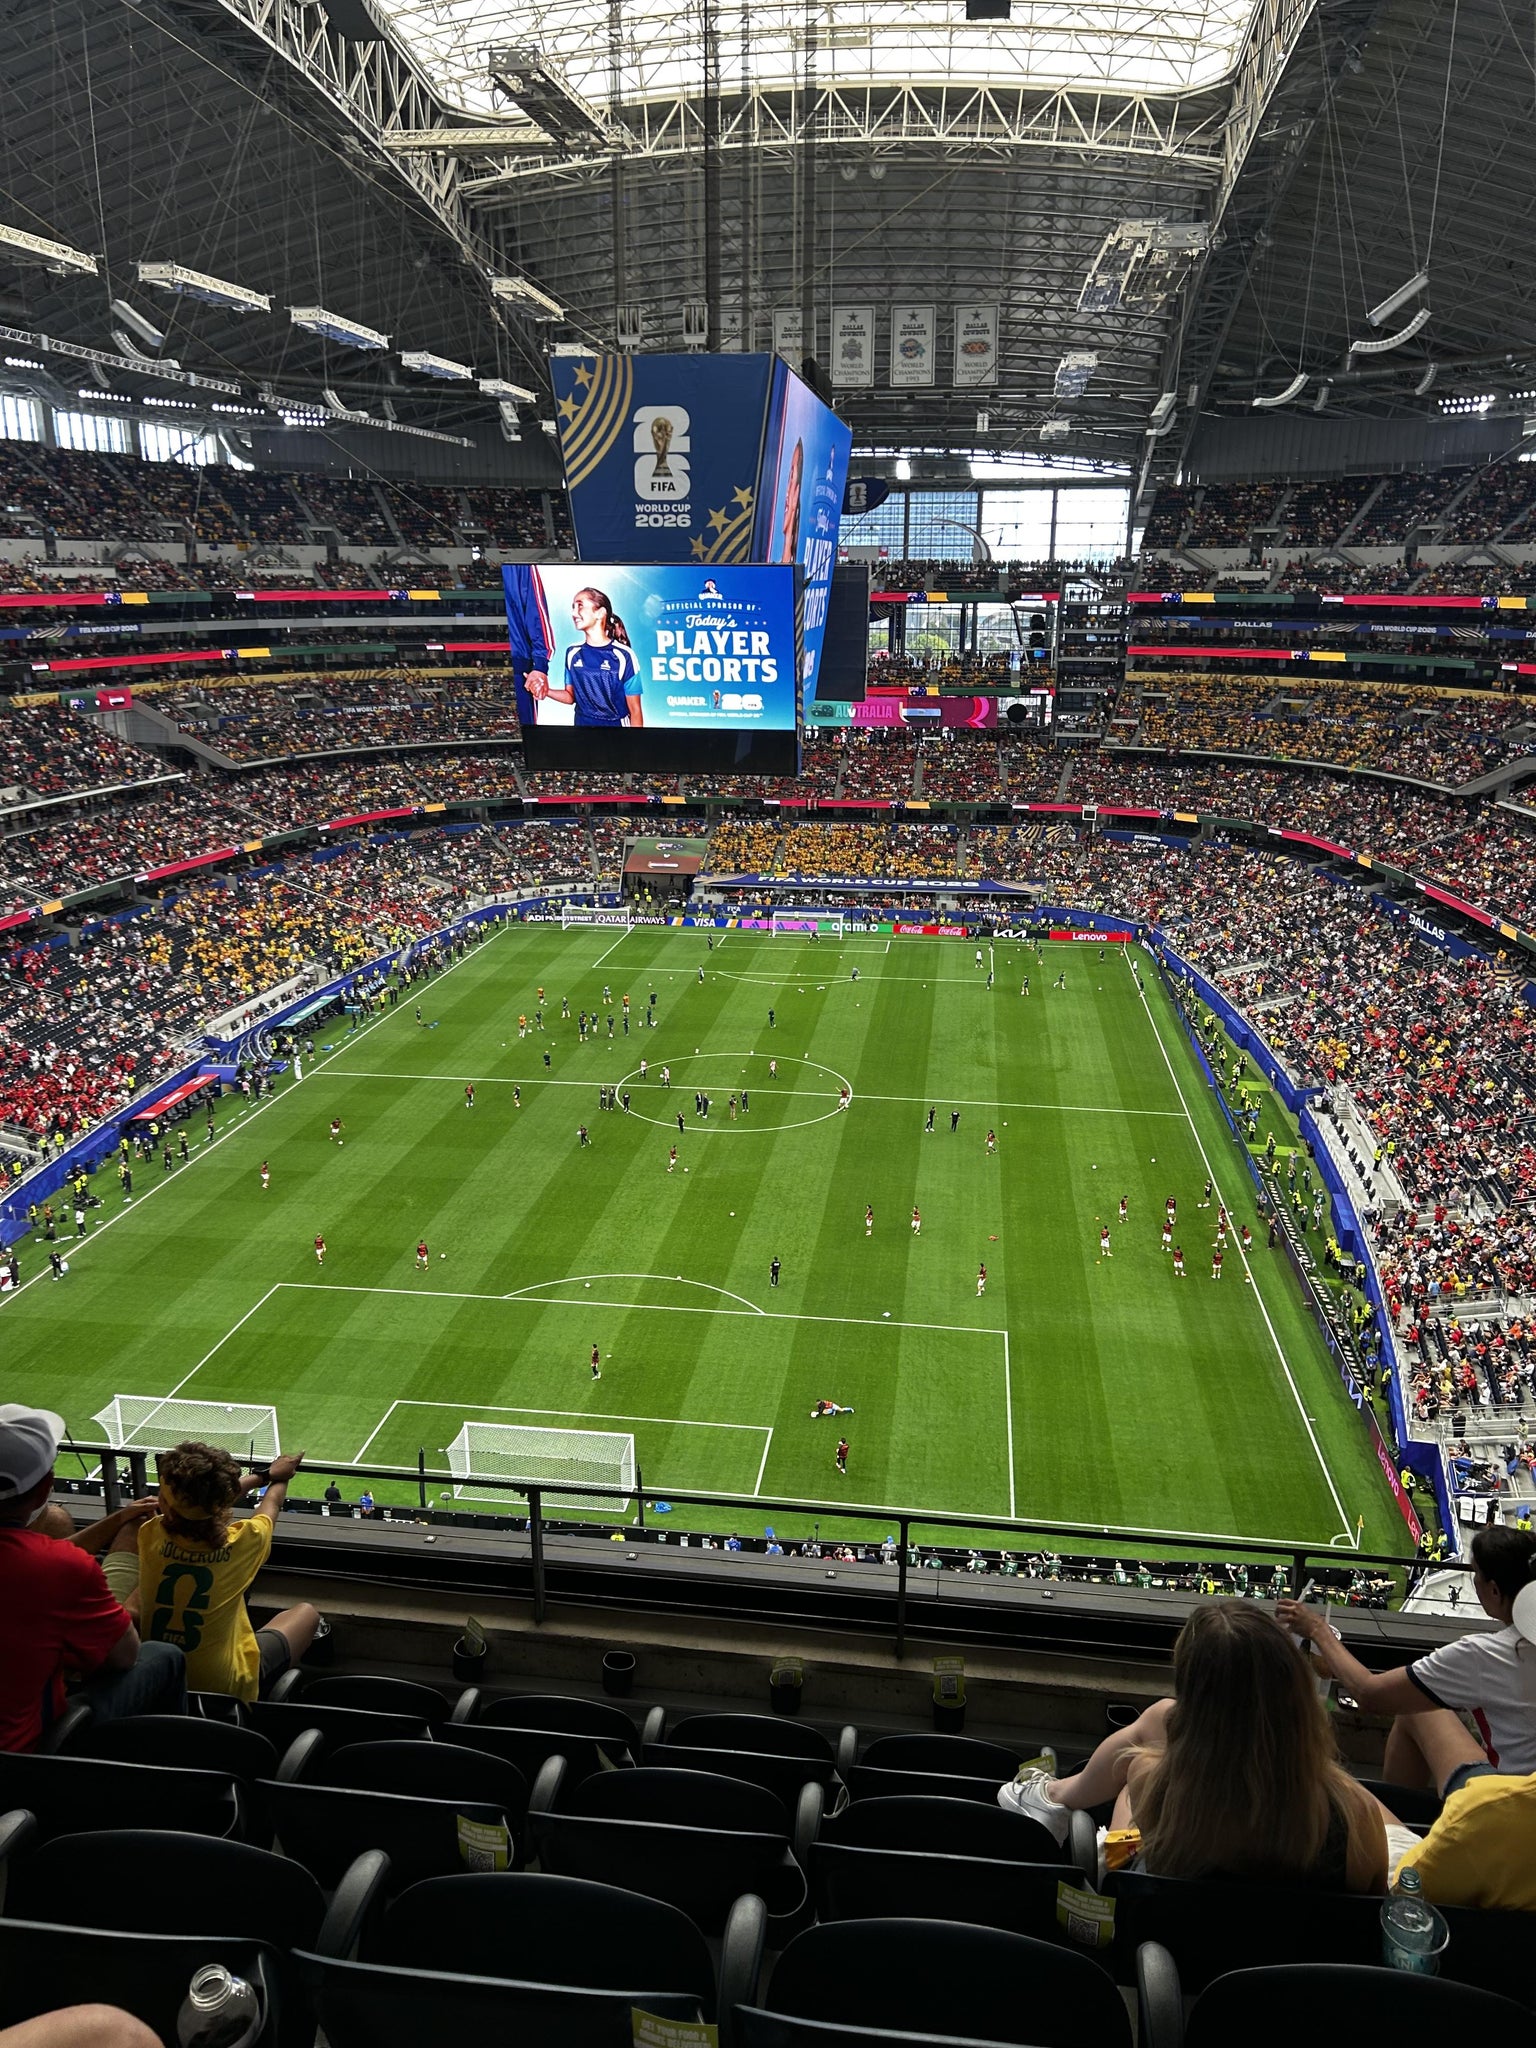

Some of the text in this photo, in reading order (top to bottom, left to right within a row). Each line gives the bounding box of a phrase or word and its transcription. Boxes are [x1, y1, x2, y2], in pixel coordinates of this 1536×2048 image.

[833, 369, 870, 377] CHAMPIONS
[894, 368, 931, 376] CHAMPIONS
[651, 482, 676, 491] FIFA
[635, 504, 691, 513] WORLD CUP
[635, 514, 691, 527] 2026
[666, 602, 703, 611] OFFICIAL
[707, 601, 743, 610] SPONSOR
[686, 614, 738, 630] Today's
[1370, 624, 1384, 632] FIFA
[1417, 626, 1437, 634] 2026
[656, 630, 770, 656] PLAYER
[650, 657, 778, 683] ESCORTS
[801, 877, 869, 885] WORLD
[597, 914, 666, 925] QATAR AIRWAYS
[692, 917, 716, 928] VISA
[1409, 912, 1446, 941] DALLAS
[1072, 932, 1107, 942] Lenovo
[1377, 1440, 1400, 1497] Lenovo
